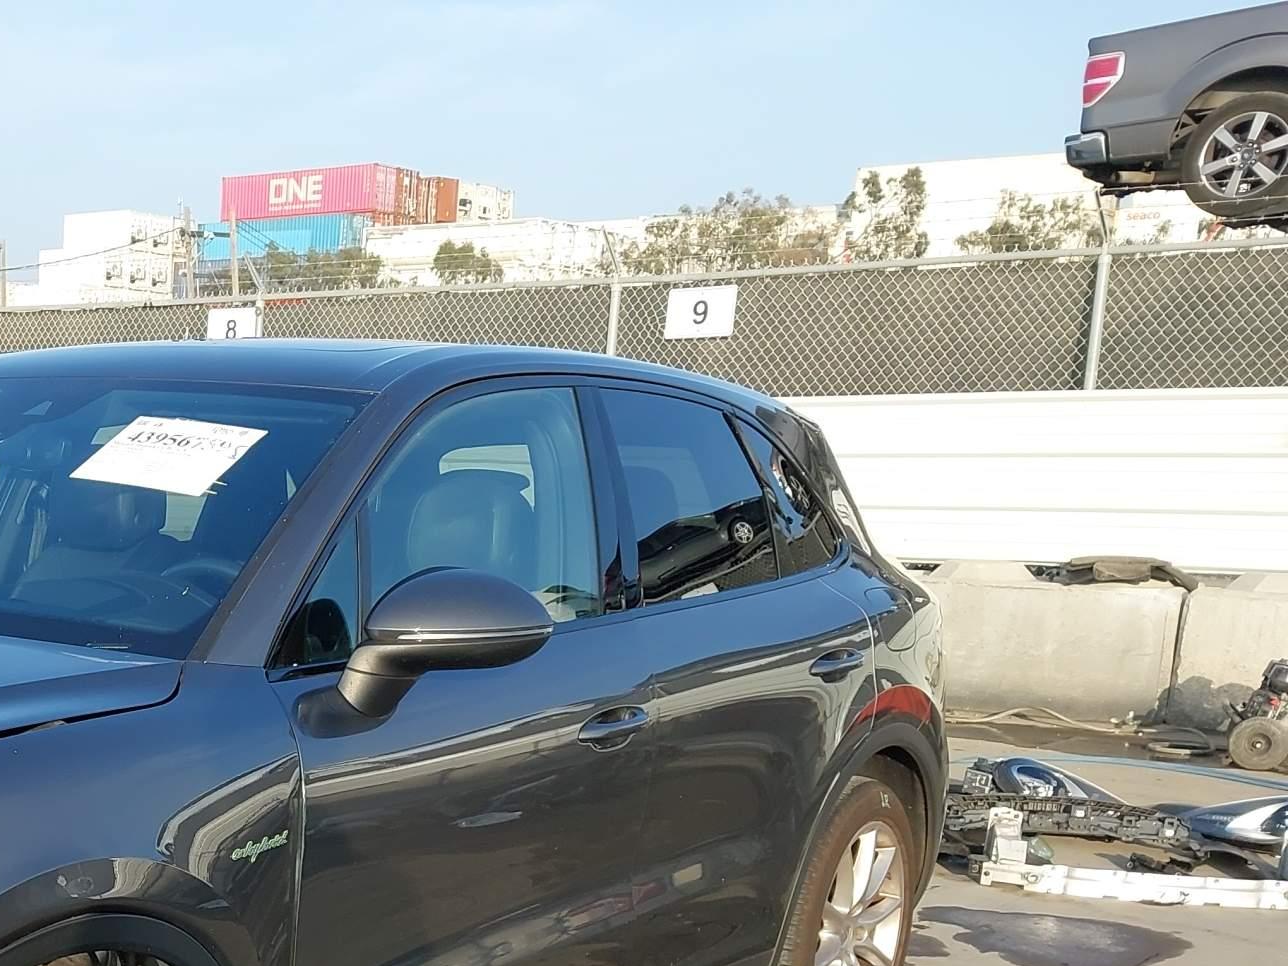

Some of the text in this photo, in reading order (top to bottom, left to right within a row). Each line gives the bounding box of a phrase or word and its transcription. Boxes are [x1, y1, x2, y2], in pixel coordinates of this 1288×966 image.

[269, 175, 322, 204] ONE
[1126, 211, 1161, 221] seaco
[693, 300, 709, 325] 9
[226, 319, 237, 338] 8
